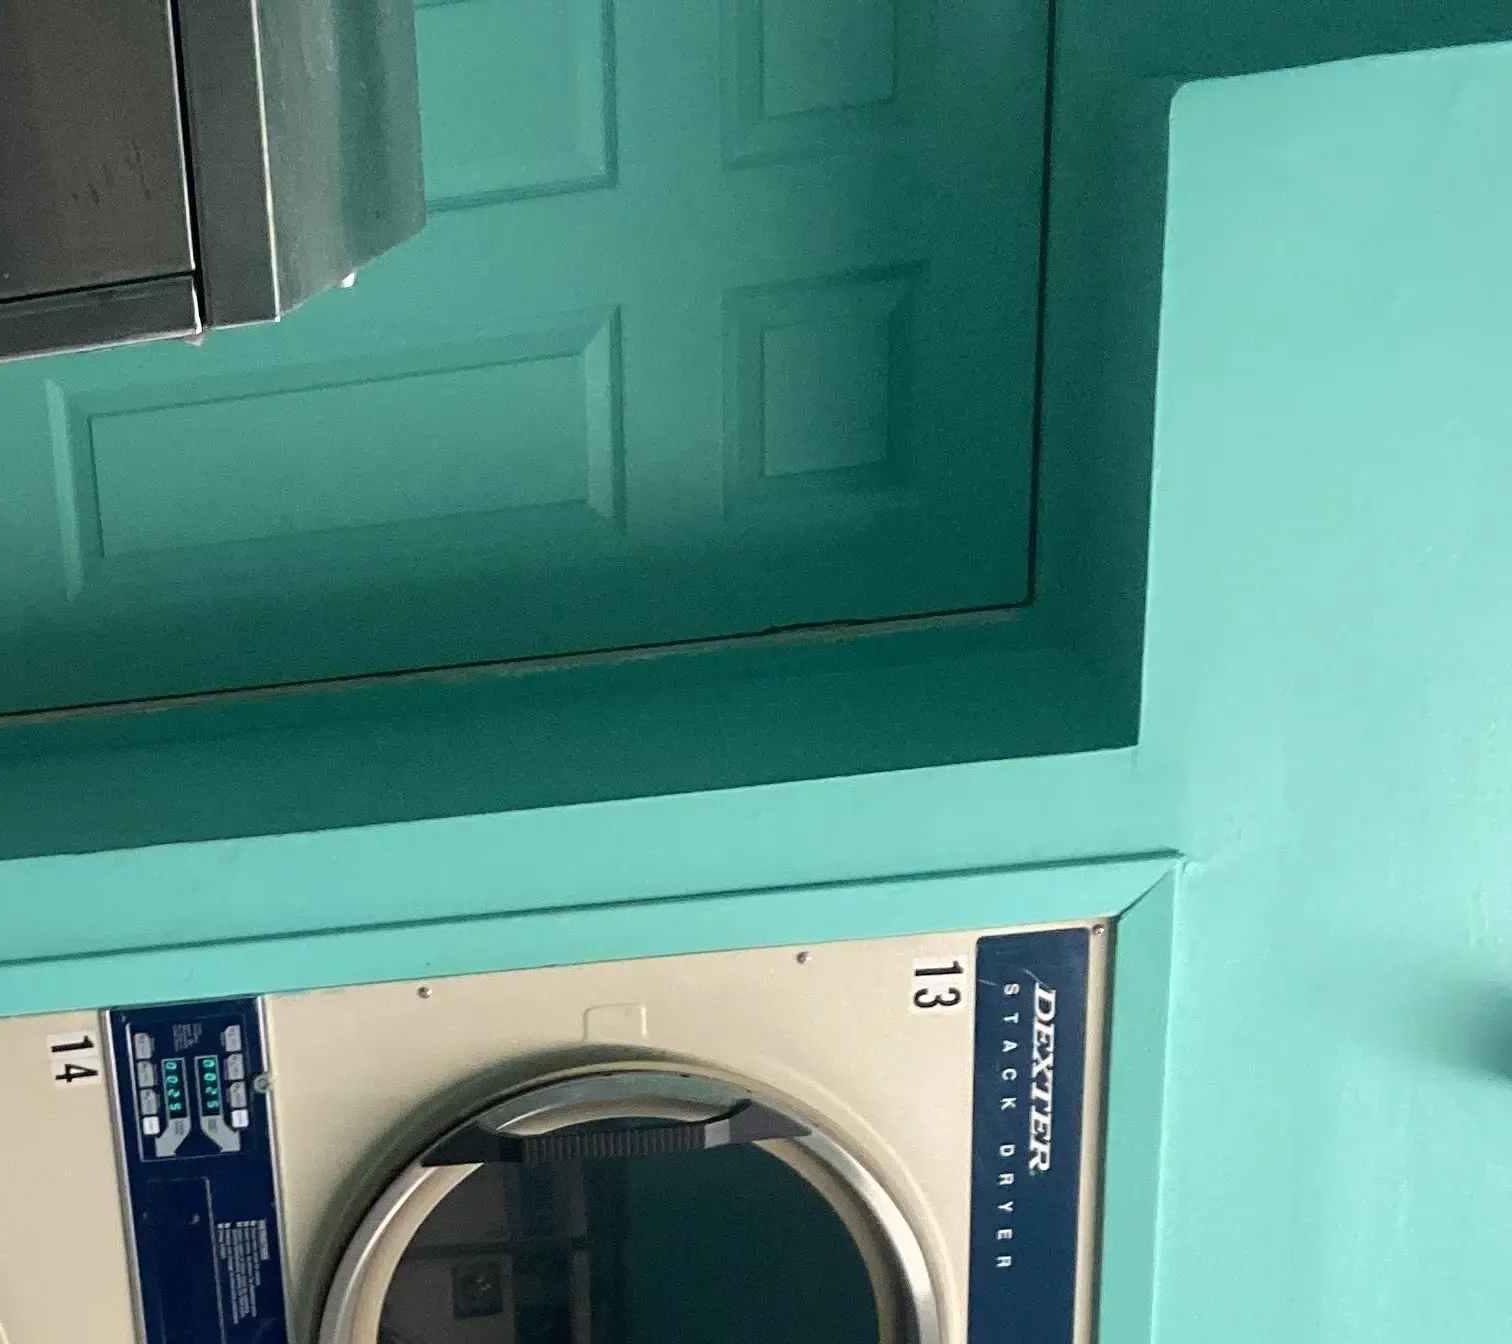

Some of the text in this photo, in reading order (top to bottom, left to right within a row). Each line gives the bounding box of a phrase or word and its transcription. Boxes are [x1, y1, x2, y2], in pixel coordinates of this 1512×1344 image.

[913, 959, 961, 1010] 13
[50, 1035, 98, 1084] 14
[1028, 982, 1056, 1174] DEXTER
[995, 982, 1020, 1269] STACK DRYER
